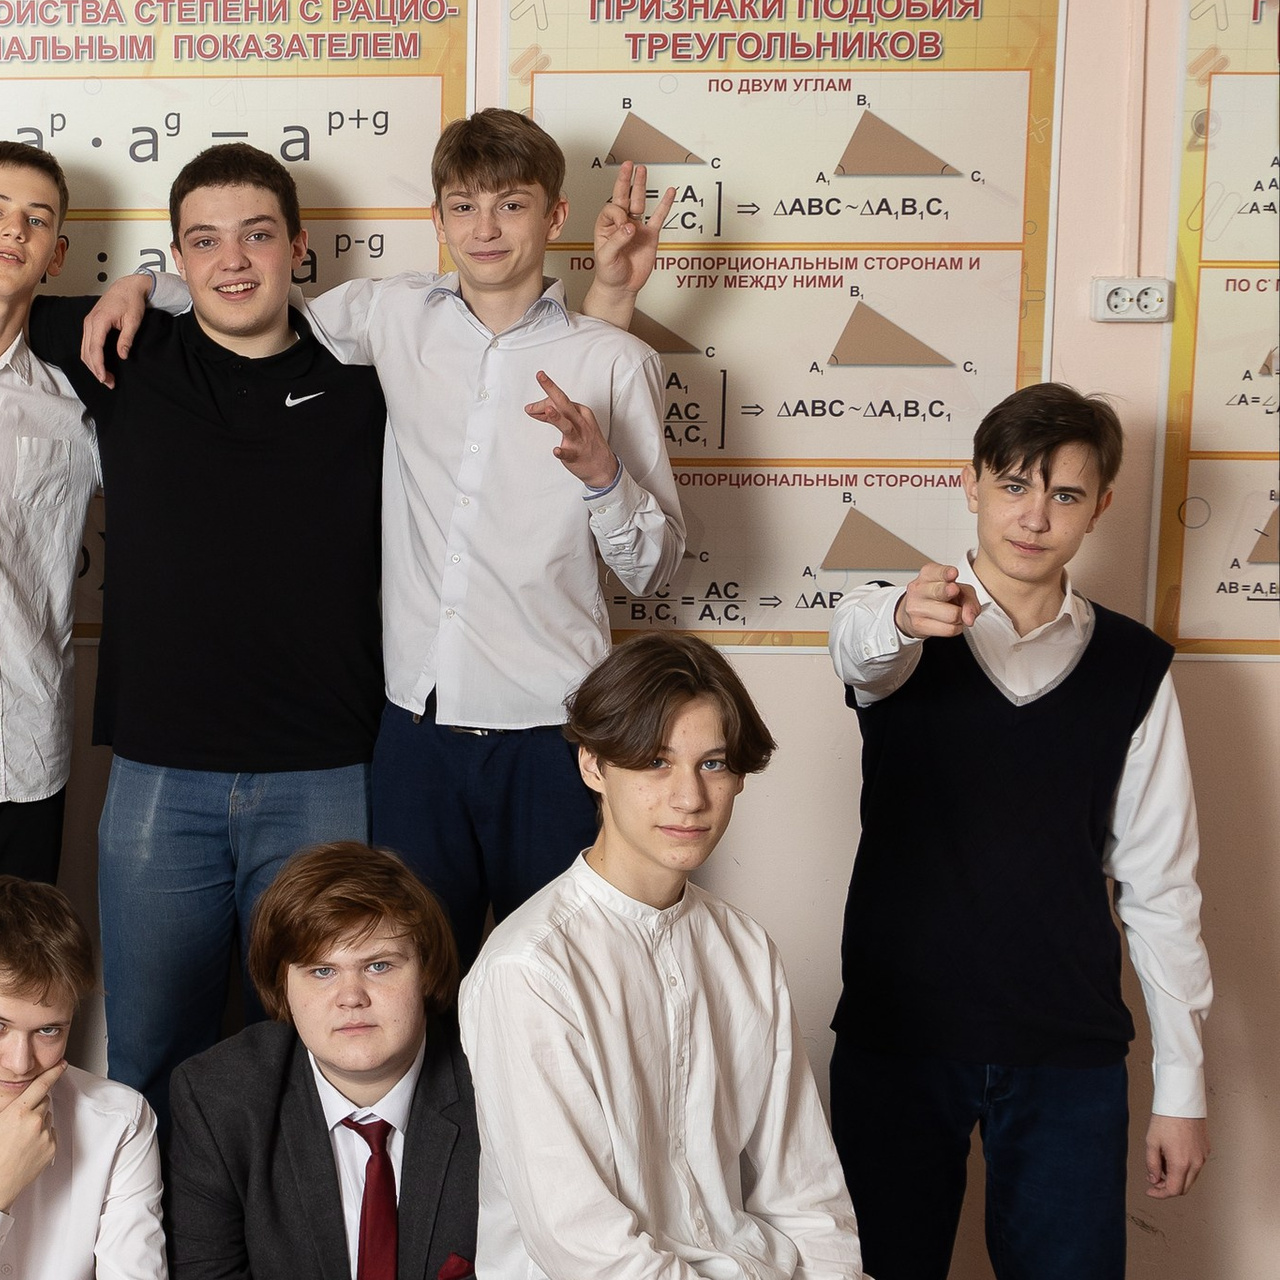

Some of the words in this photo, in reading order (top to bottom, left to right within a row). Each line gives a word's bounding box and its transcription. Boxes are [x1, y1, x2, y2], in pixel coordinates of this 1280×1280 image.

[173, 31, 419, 60] ПОКАЗАТЕЛЕМ
[623, 29, 942, 61] ТРЕУГОЛЬНИКОВ
[708, 78, 734, 93] ПО
[737, 78, 787, 95] ДВУМ
[792, 78, 852, 92] УГЛАМ
[570, 256, 595, 271] ПО
[655, 257, 858, 273] ПРОПОРЦИОНАЛЬНЫМ
[863, 256, 963, 271] СТОРОНАМ
[968, 256, 981, 271] И
[676, 274, 720, 289] УГЛУ
[723, 274, 788, 291] МЕЖДУ
[793, 275, 844, 289] НИМИ
[674, 473, 858, 489] ОПОРЦИОНАЛЬНЫМ
[863, 473, 962, 488] СТОРОНАМ
